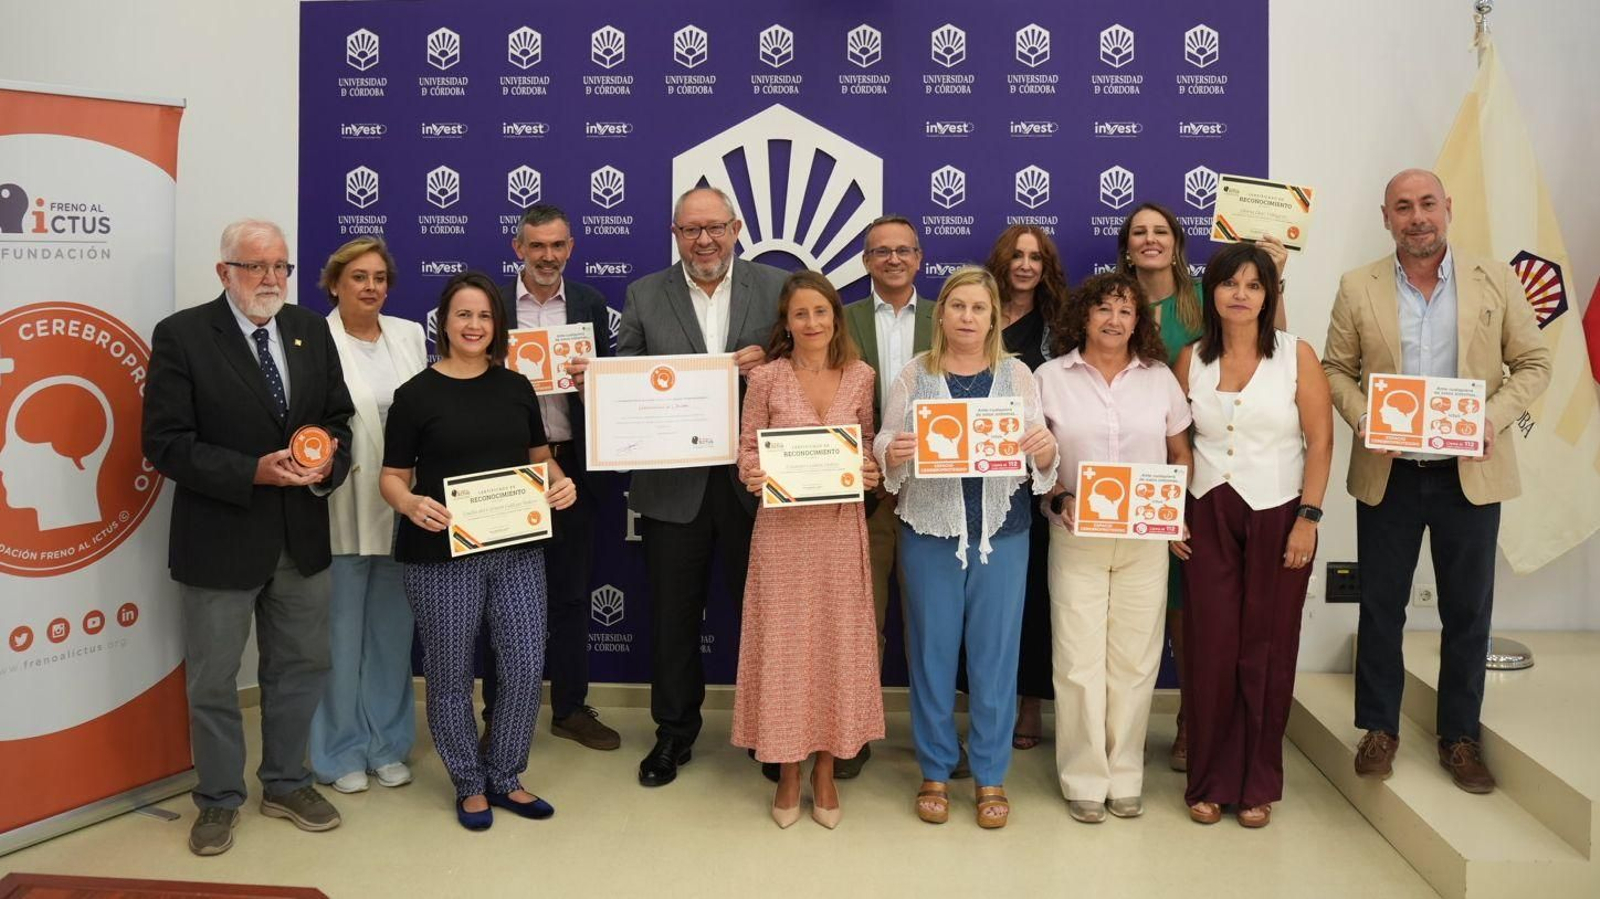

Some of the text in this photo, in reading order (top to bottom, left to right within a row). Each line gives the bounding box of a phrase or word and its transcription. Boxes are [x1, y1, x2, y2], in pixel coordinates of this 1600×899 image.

[339, 78, 387, 86] UNIVERSIDAD
[419, 77, 468, 85] UNIVERSIDAD
[500, 77, 549, 85] UNIVERSIDAD
[583, 76, 633, 84] UNIVERSIDAD
[666, 75, 716, 84] UNIVERSIDAD
[751, 75, 802, 84] UNIVERSIDAD
[839, 75, 890, 83] UNIVERSIDAD
[923, 75, 974, 83] UNIVERSIDAD
[1008, 75, 1058, 83] UNIVERSIDAD
[1092, 75, 1143, 84] UNIVERSIDAD
[1177, 75, 1227, 84] UNIVERSIDAD
[350, 86, 384, 96] CÓRDOBA
[430, 85, 465, 95] CÓRDOBA
[511, 85, 546, 95] CÓRDOBA
[594, 84, 630, 94] CÓRDOBA
[677, 84, 713, 94] CÓRDOBA
[763, 84, 799, 94] CÓRDOBA
[851, 83, 887, 94] CÓRDOBA
[935, 83, 971, 93] CÓRDOBA
[1019, 83, 1055, 93] CÓRDOBA
[1104, 84, 1139, 94] CÓRDOBA
[1188, 84, 1224, 94] CÓRDOBA
[50, 203, 104, 212] FRENO AL
[1239, 197, 1293, 209] RECONOCIMIENTO
[339, 216, 387, 224] UNIVERSIDAD
[419, 216, 468, 224] UNIVERSIDAD
[583, 216, 633, 224] UNIVERSIDAD
[923, 216, 974, 225] UNIVERSIDAD
[1007, 216, 1058, 225] UNIVERSIDAD
[349, 224, 384, 234] CÓRDOBA
[430, 224, 465, 234] CÓRDOBA
[594, 224, 630, 235] CÓRDOBA
[934, 225, 971, 235] CÓRDOBA
[1, 245, 111, 260] FUNDACIÓN
[783, 448, 840, 457] RECONOCIMIENTO
[470, 488, 526, 504] RECONOCIMIENTO
[40, 547, 75, 560] FRENO
[78, 541, 91, 552] AL
[92, 521, 119, 544] ICTUS
